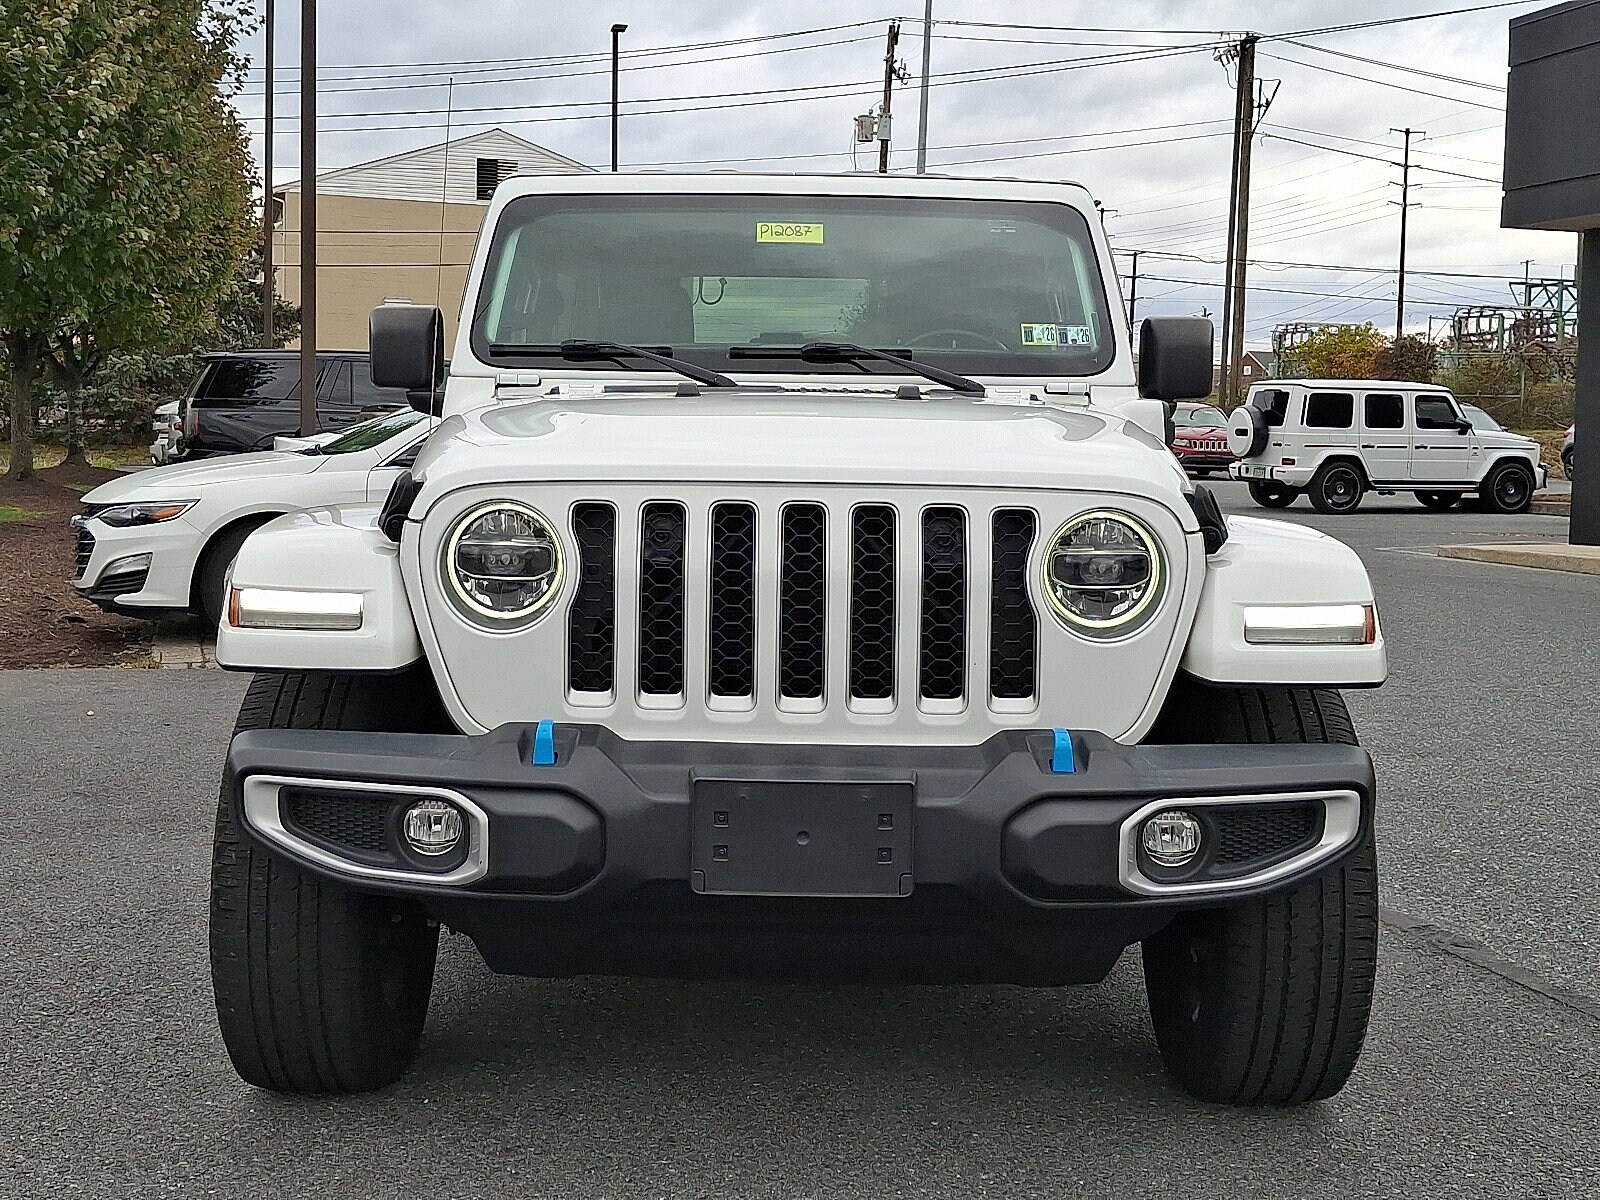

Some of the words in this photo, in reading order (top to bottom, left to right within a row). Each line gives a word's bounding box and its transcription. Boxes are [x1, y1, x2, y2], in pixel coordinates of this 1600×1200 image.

[760, 224, 812, 239] P12087
[1045, 327, 1055, 341] 26
[1081, 328, 1090, 343] 26
